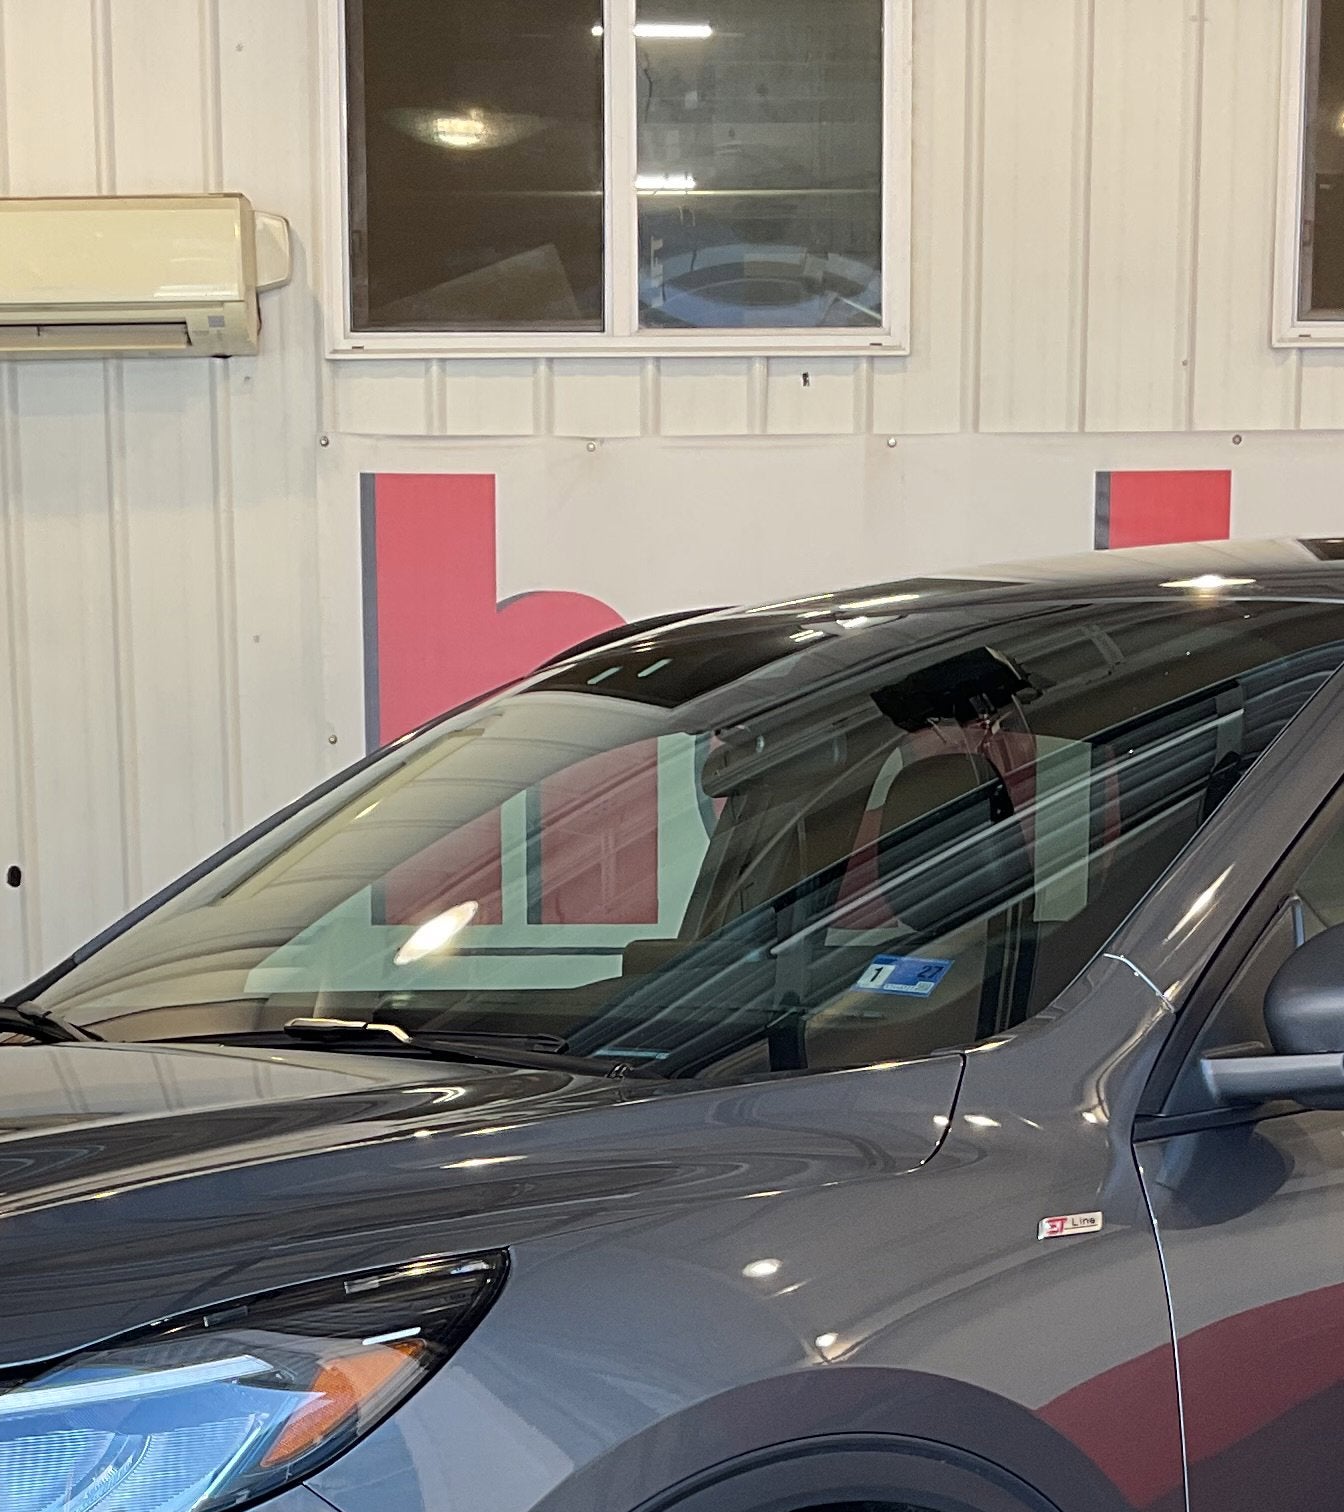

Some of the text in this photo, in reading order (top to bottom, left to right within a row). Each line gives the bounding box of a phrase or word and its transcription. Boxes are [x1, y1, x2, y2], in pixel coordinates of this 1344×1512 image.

[870, 965, 946, 982] 1 27
[1071, 1216, 1096, 1227] Line
